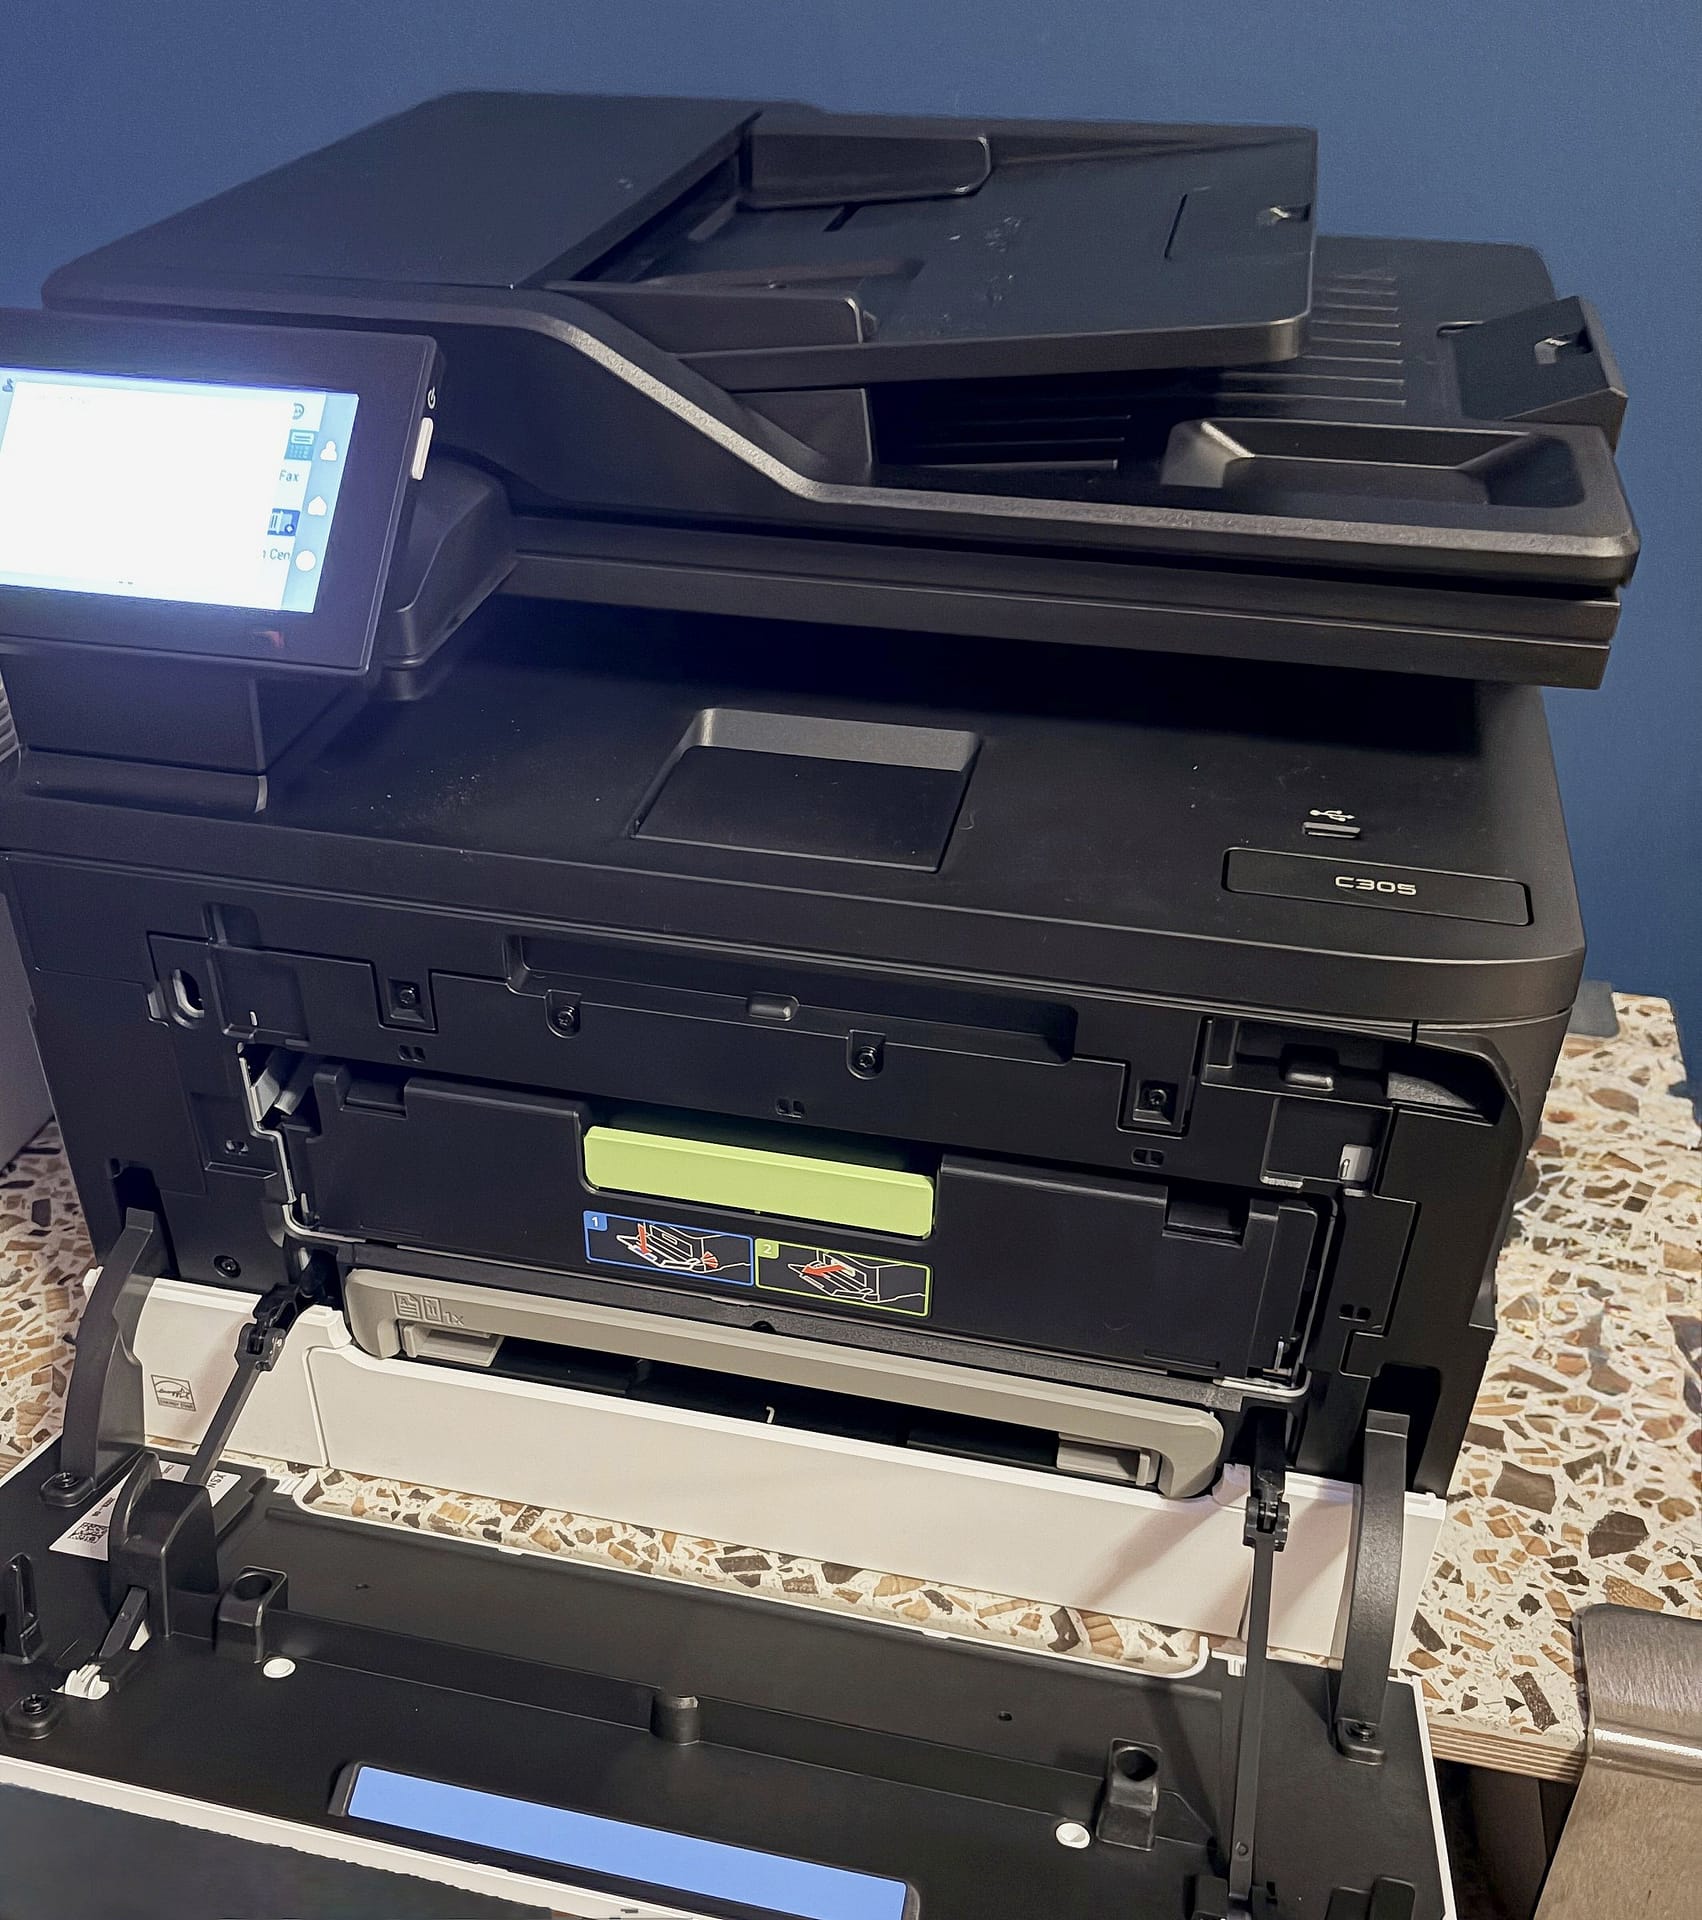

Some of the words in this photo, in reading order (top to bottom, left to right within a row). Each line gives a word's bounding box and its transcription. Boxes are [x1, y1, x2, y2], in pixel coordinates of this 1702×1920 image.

[279, 469, 300, 482] Fax
[1335, 875, 1417, 896] C305
[591, 1216, 599, 1228] 1
[763, 1243, 772, 1255] 2
